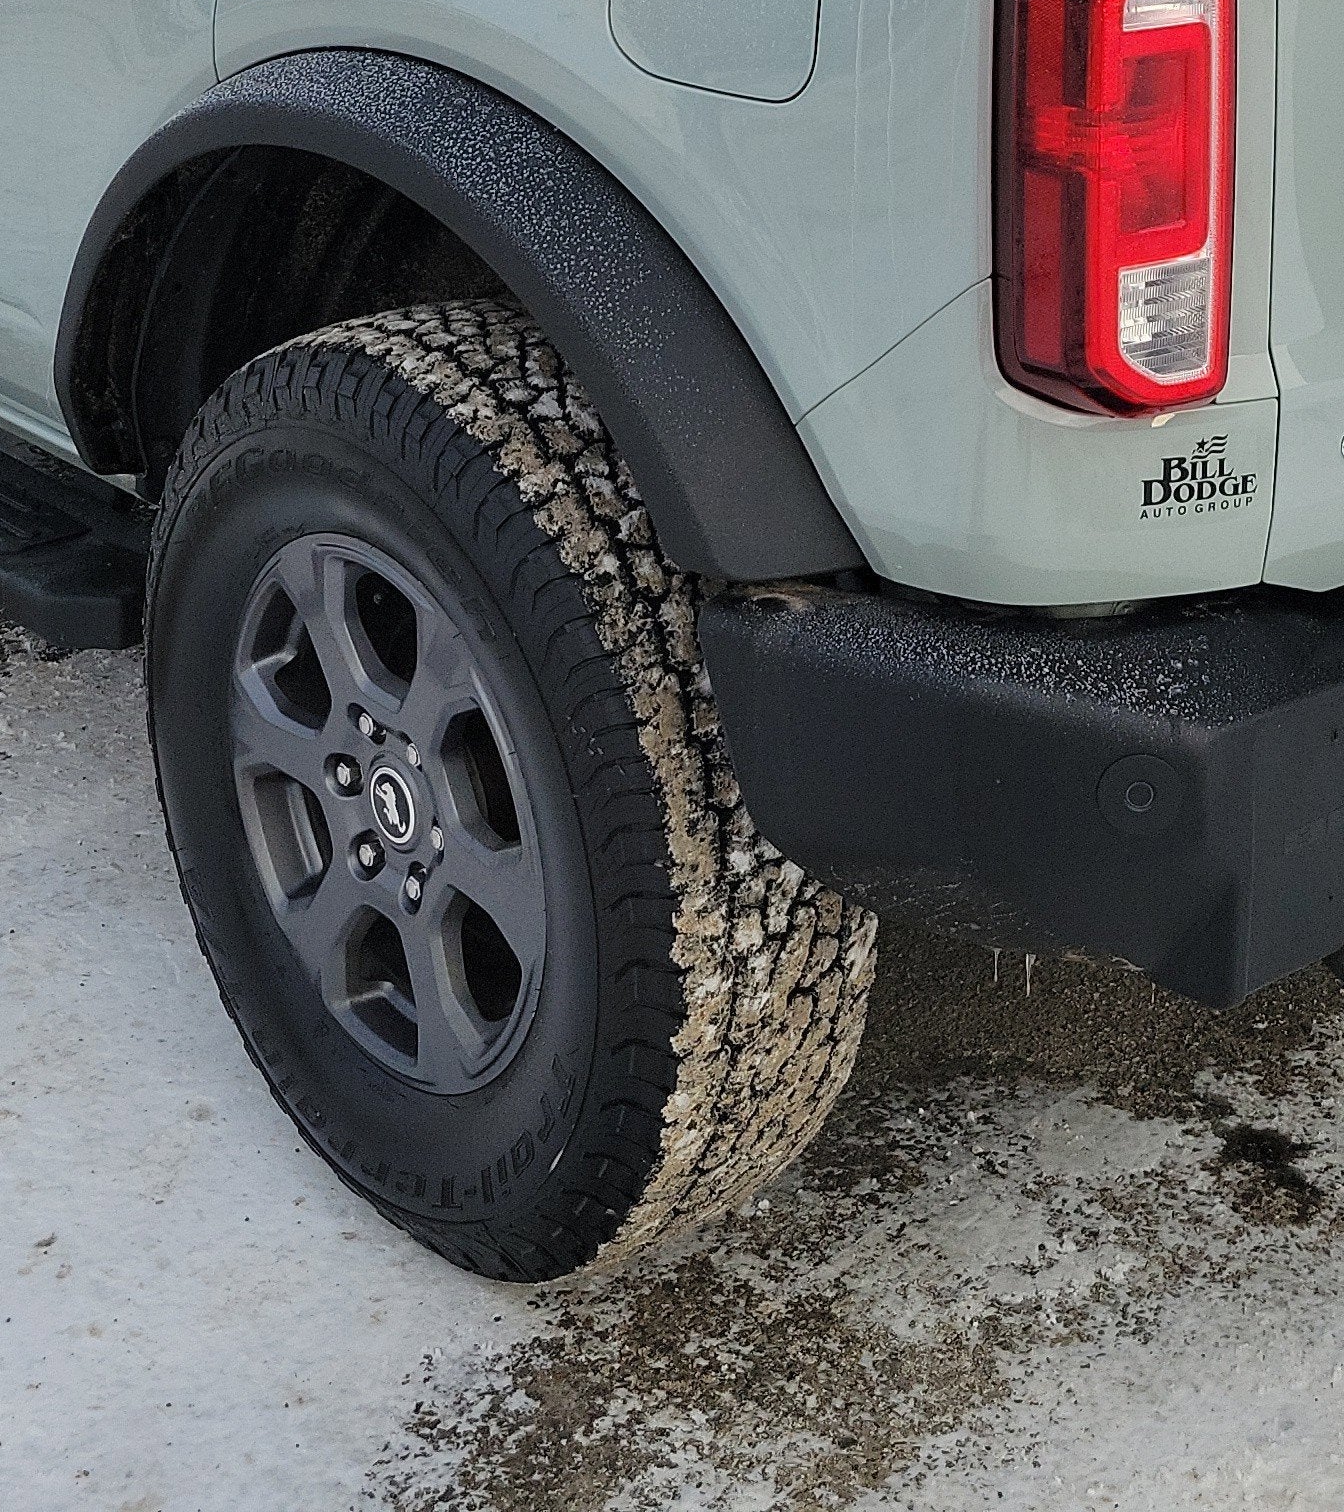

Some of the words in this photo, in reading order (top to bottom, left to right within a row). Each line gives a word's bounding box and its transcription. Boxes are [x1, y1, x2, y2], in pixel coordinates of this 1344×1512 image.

[1161, 457, 1234, 483] BILL
[1141, 473, 1257, 506] DODGE
[1140, 506, 1187, 519] AUTO
[1195, 496, 1253, 513] GROUP
